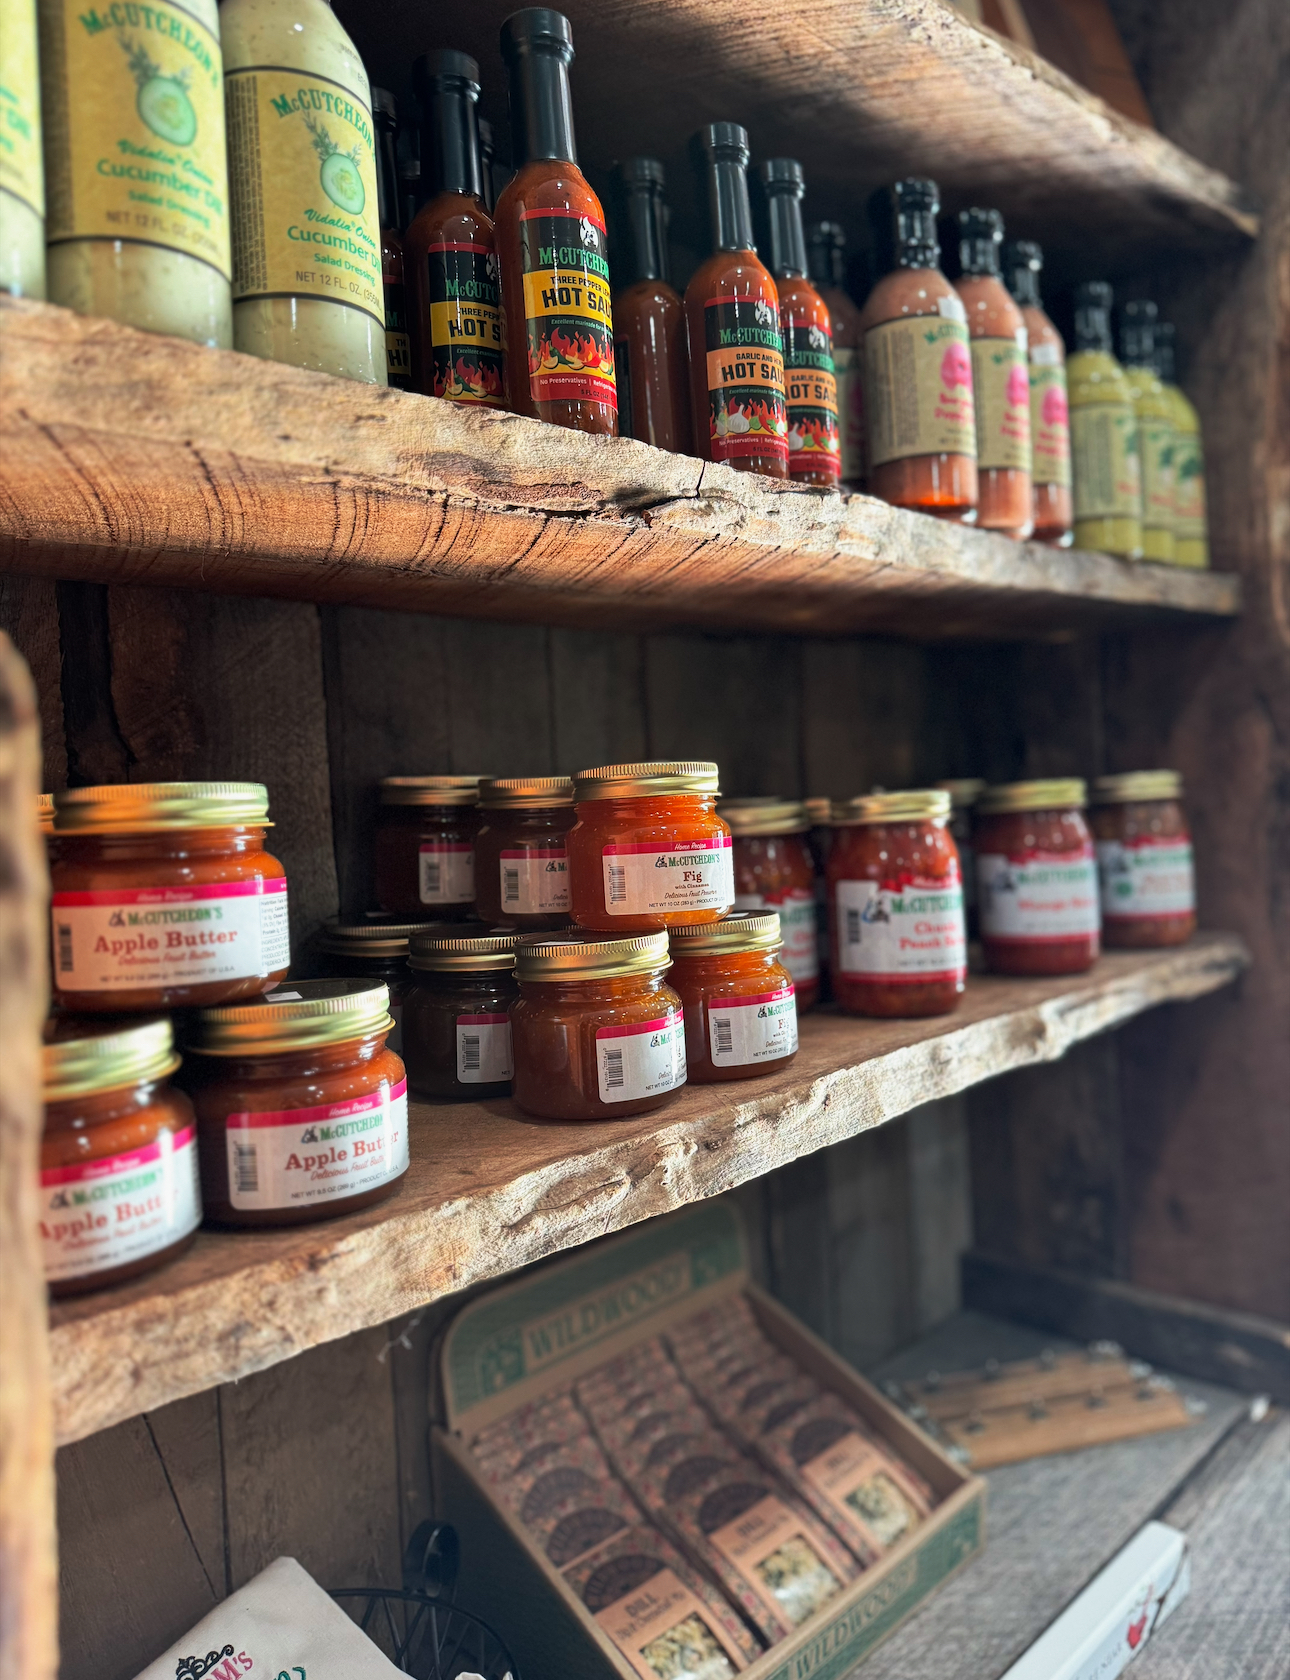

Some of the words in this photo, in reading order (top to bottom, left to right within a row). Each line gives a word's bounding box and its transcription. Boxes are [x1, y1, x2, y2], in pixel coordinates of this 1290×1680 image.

[96, 158, 202, 199] Cucumber
[287, 225, 369, 261] Cucumber
[295, 270, 316, 283] NET
[319, 274, 331, 286] 12
[314, 252, 342, 268] Salad
[344, 260, 376, 288] Dressing
[541, 287, 582, 309] HOT
[587, 290, 612, 319] SAU
[448, 318, 487, 338] HOT
[736, 352, 760, 360] GARLIC
[549, 376, 588, 384] Preservatives
[722, 362, 756, 382] HOT
[761, 363, 784, 384] SAU
[668, 853, 721, 868] McCUTCHEON'S
[682, 871, 702, 883] Fig
[127, 906, 223, 926] McCUTCHEON'S
[94, 935, 160, 955] Apple
[165, 930, 238, 949] Butter
[285, 1147, 347, 1171] Apple
[310, 1167, 350, 1181] Delicious
[291, 1190, 304, 1199] NET
